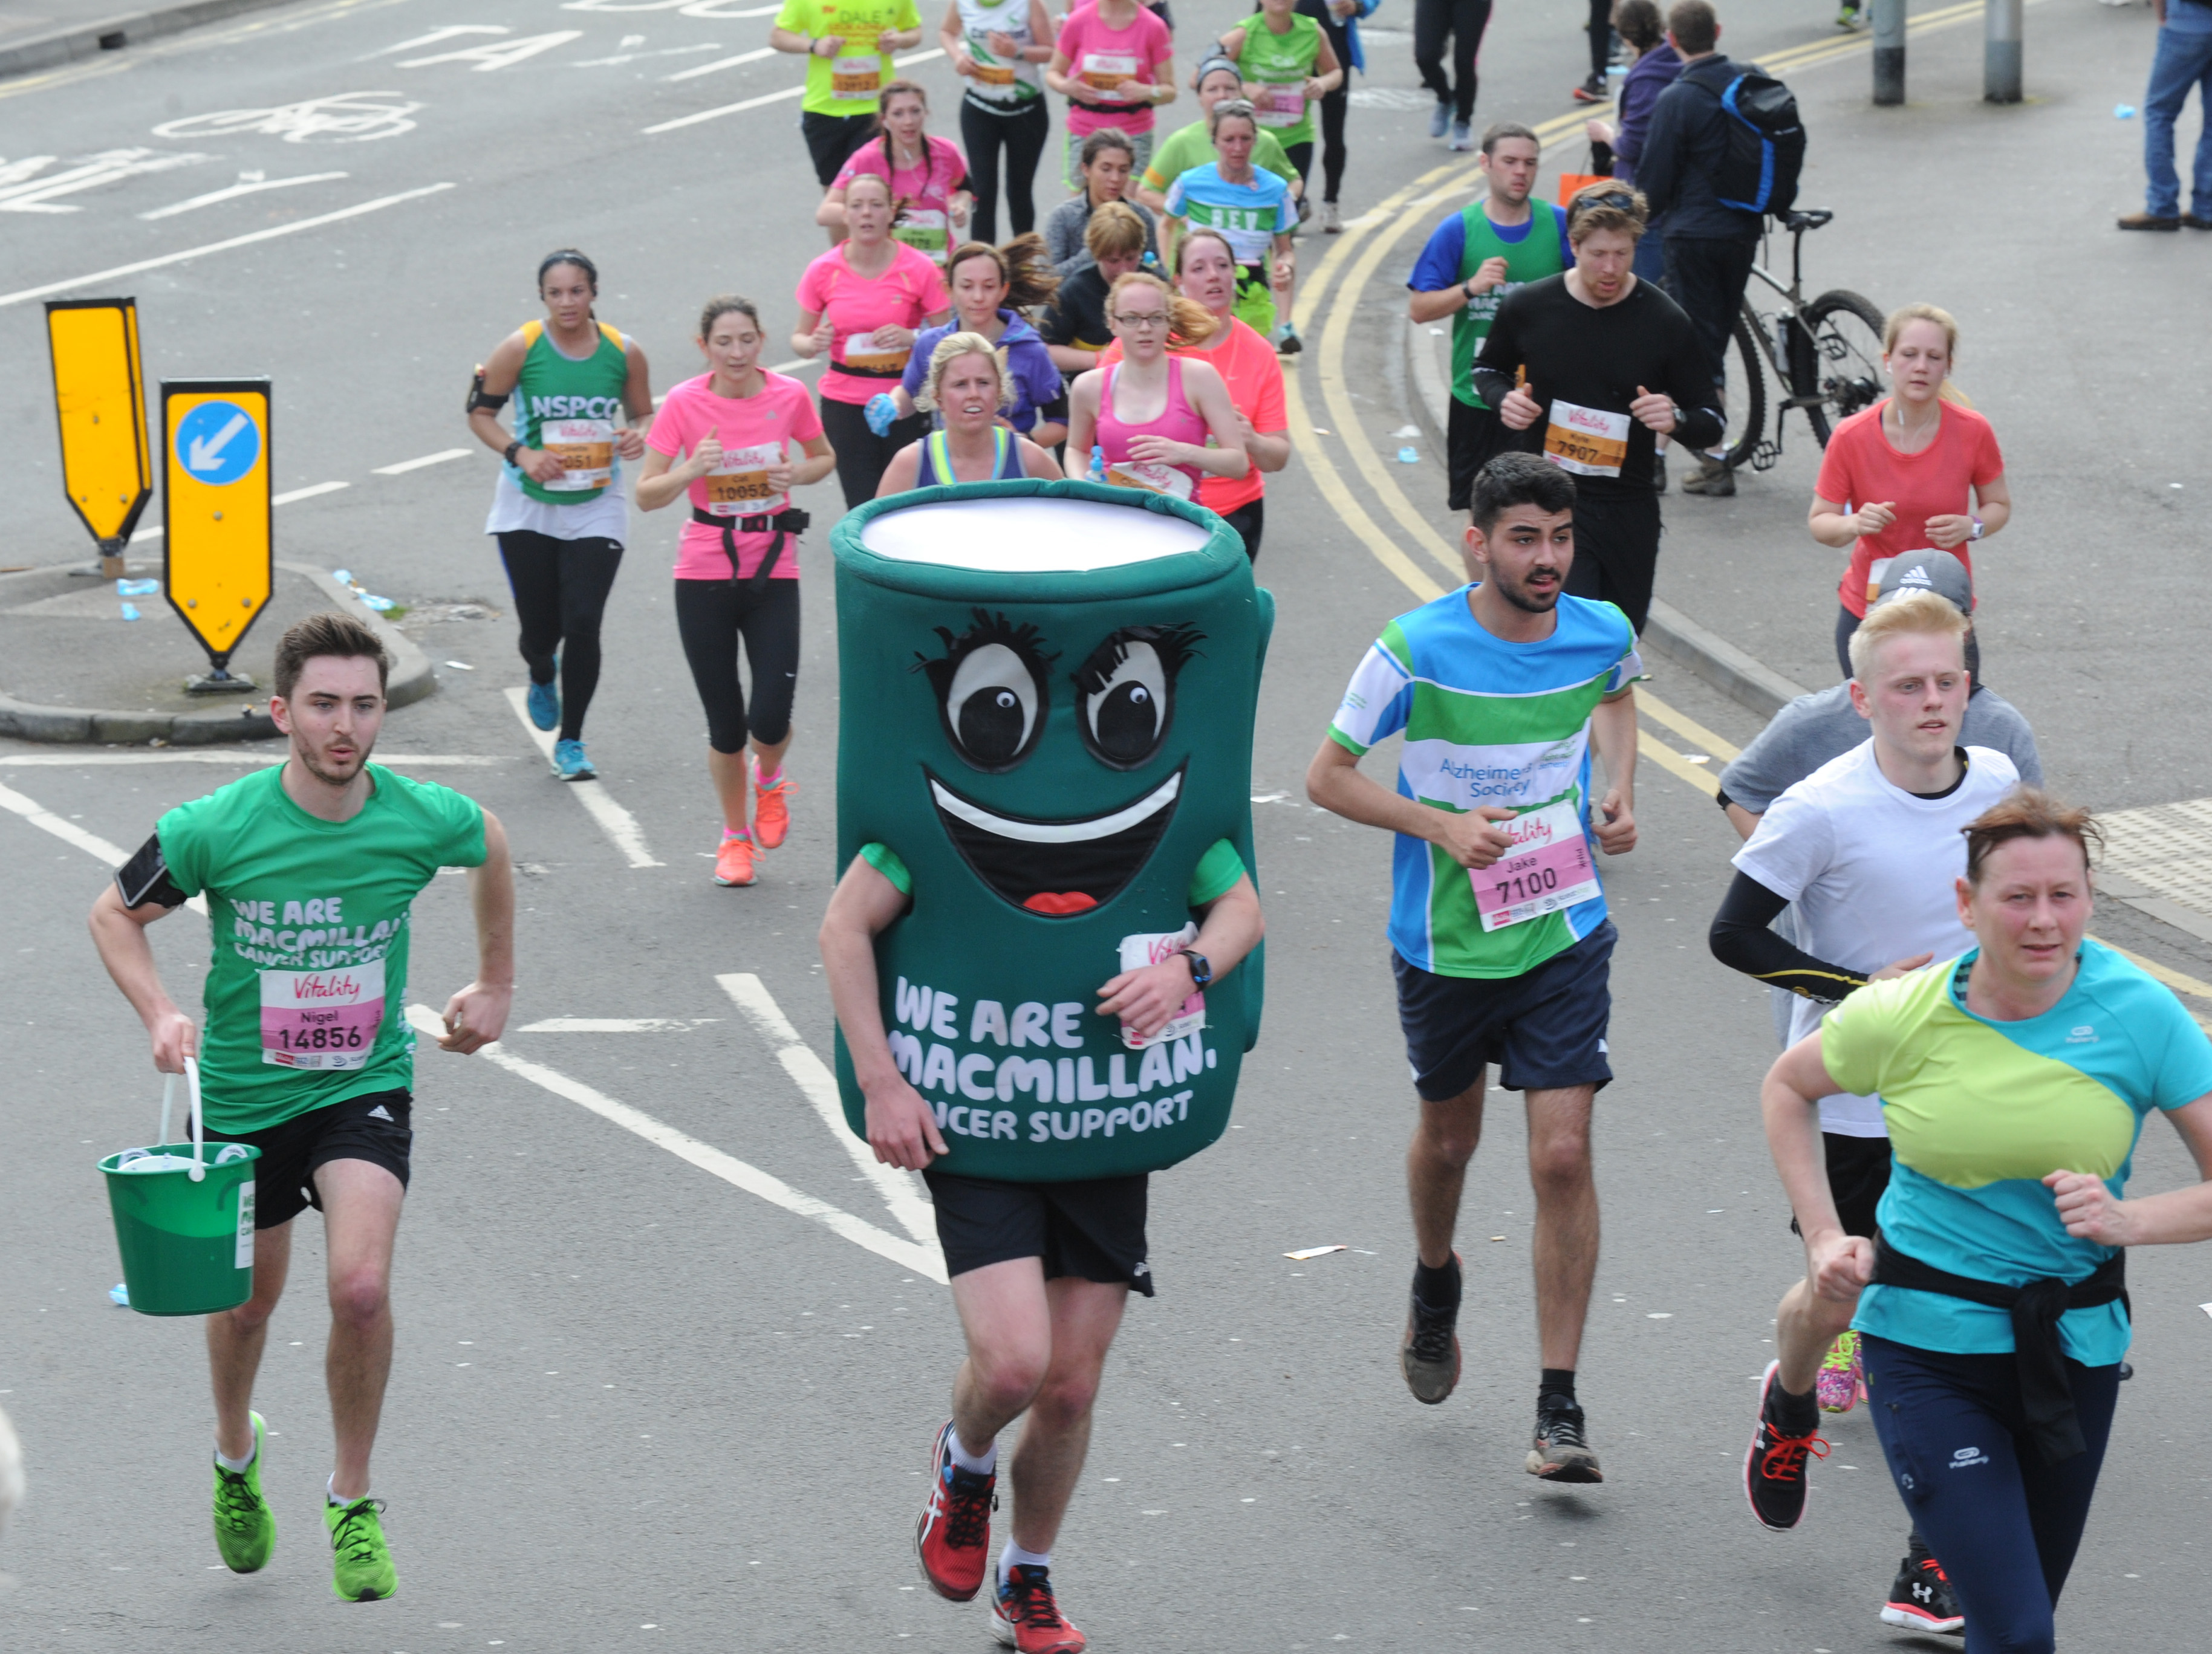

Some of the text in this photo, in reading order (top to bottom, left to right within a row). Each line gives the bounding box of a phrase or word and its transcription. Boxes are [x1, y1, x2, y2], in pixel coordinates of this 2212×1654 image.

[531, 395, 620, 419] NSPCC
[1558, 440, 1598, 463] 7907
[717, 482, 769, 501] 10052
[1507, 857, 1538, 873] Jake
[1496, 868, 1558, 904] 7100
[230, 897, 343, 926] WE ARE
[294, 973, 360, 1004] Vitality
[300, 1010, 339, 1025] Nigel
[896, 976, 1085, 1049] WE ARE
[279, 1025, 362, 1049] 14856
[924, 1089, 1194, 1143] NCER SUPPORT
